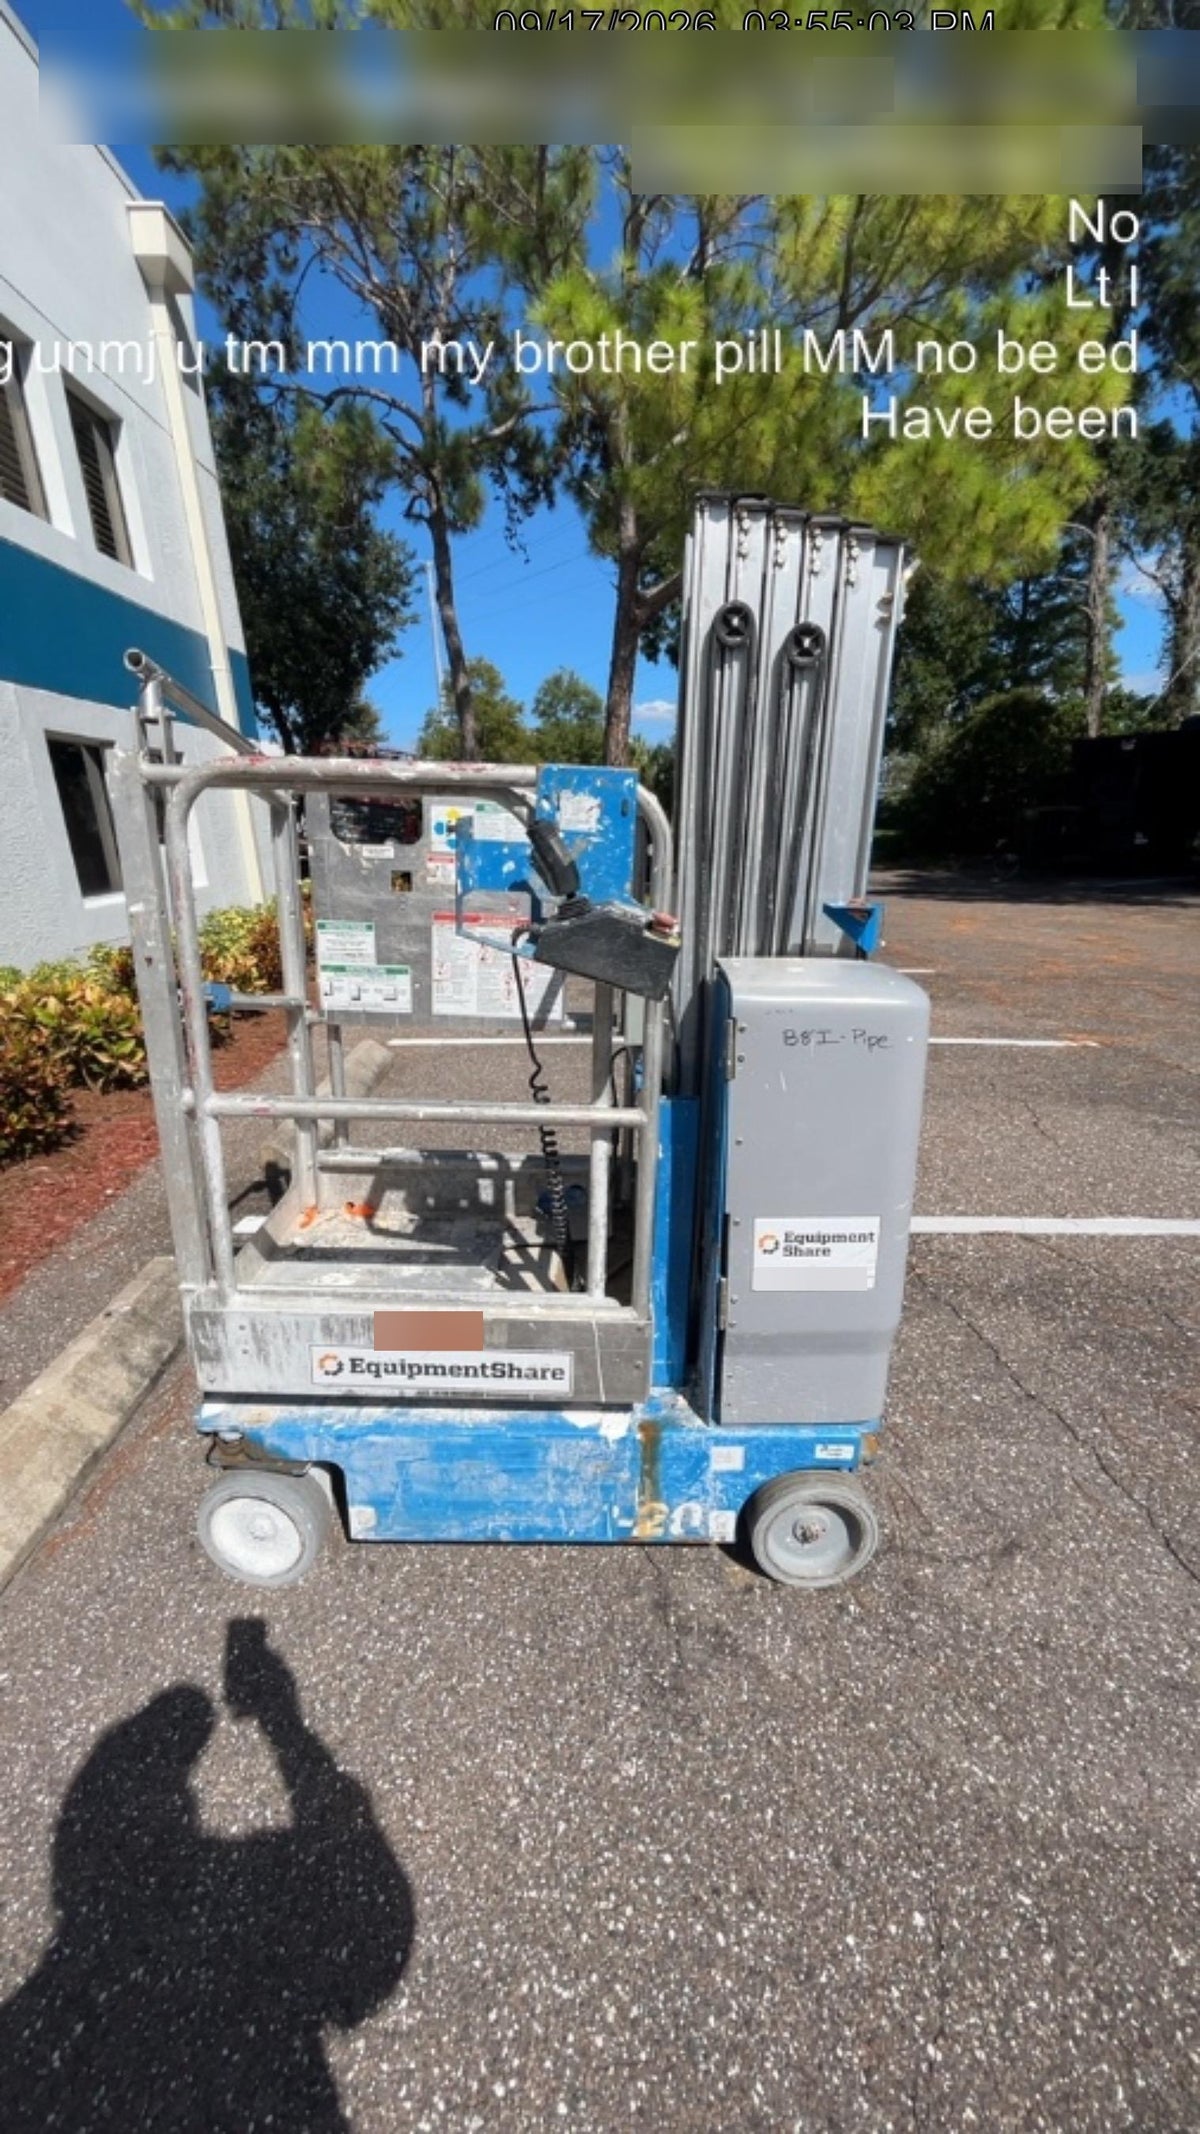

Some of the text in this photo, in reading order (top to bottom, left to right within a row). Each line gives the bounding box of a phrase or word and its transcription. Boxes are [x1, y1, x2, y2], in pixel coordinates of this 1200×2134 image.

[784, 1231, 875, 1245] Equipment
[782, 1244, 831, 1257] Share
[349, 1357, 565, 1381] EquipmentShare
